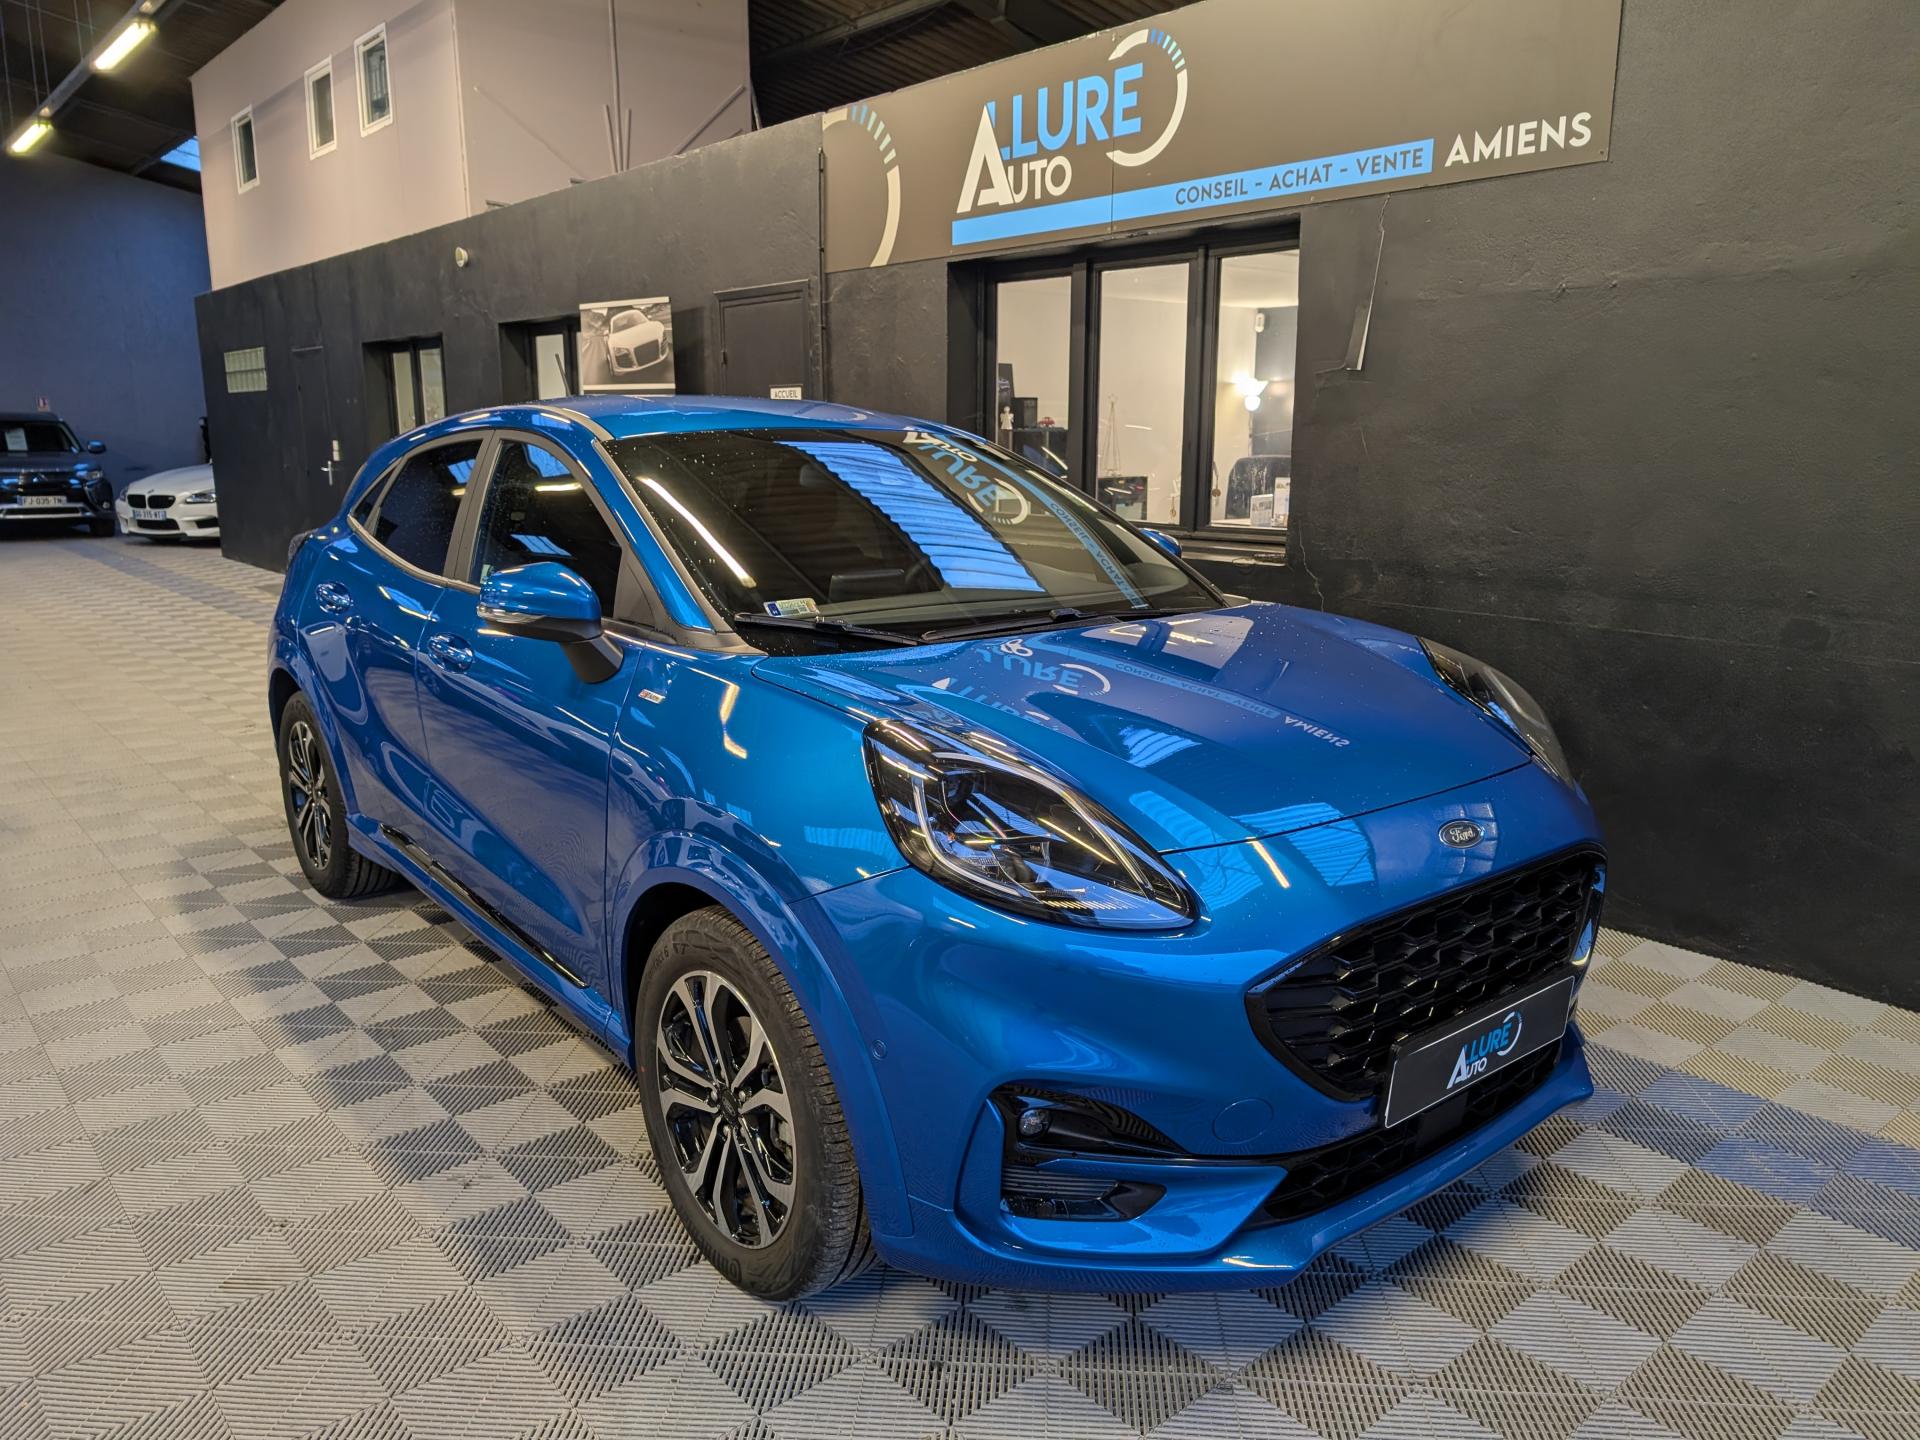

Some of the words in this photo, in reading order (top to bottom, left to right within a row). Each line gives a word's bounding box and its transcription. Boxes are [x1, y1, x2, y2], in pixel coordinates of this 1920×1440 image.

[957, 105, 1073, 213] AUTO
[1444, 111, 1592, 167] AMIENS
[1175, 178, 1249, 205] CONSEIL
[1269, 163, 1333, 191] ACHAT
[1356, 147, 1424, 176] VENTE
[775, 390, 798, 399] ACCUEIL
[1449, 826, 1475, 843] Ford
[1446, 1045, 1488, 1089] AUTO
